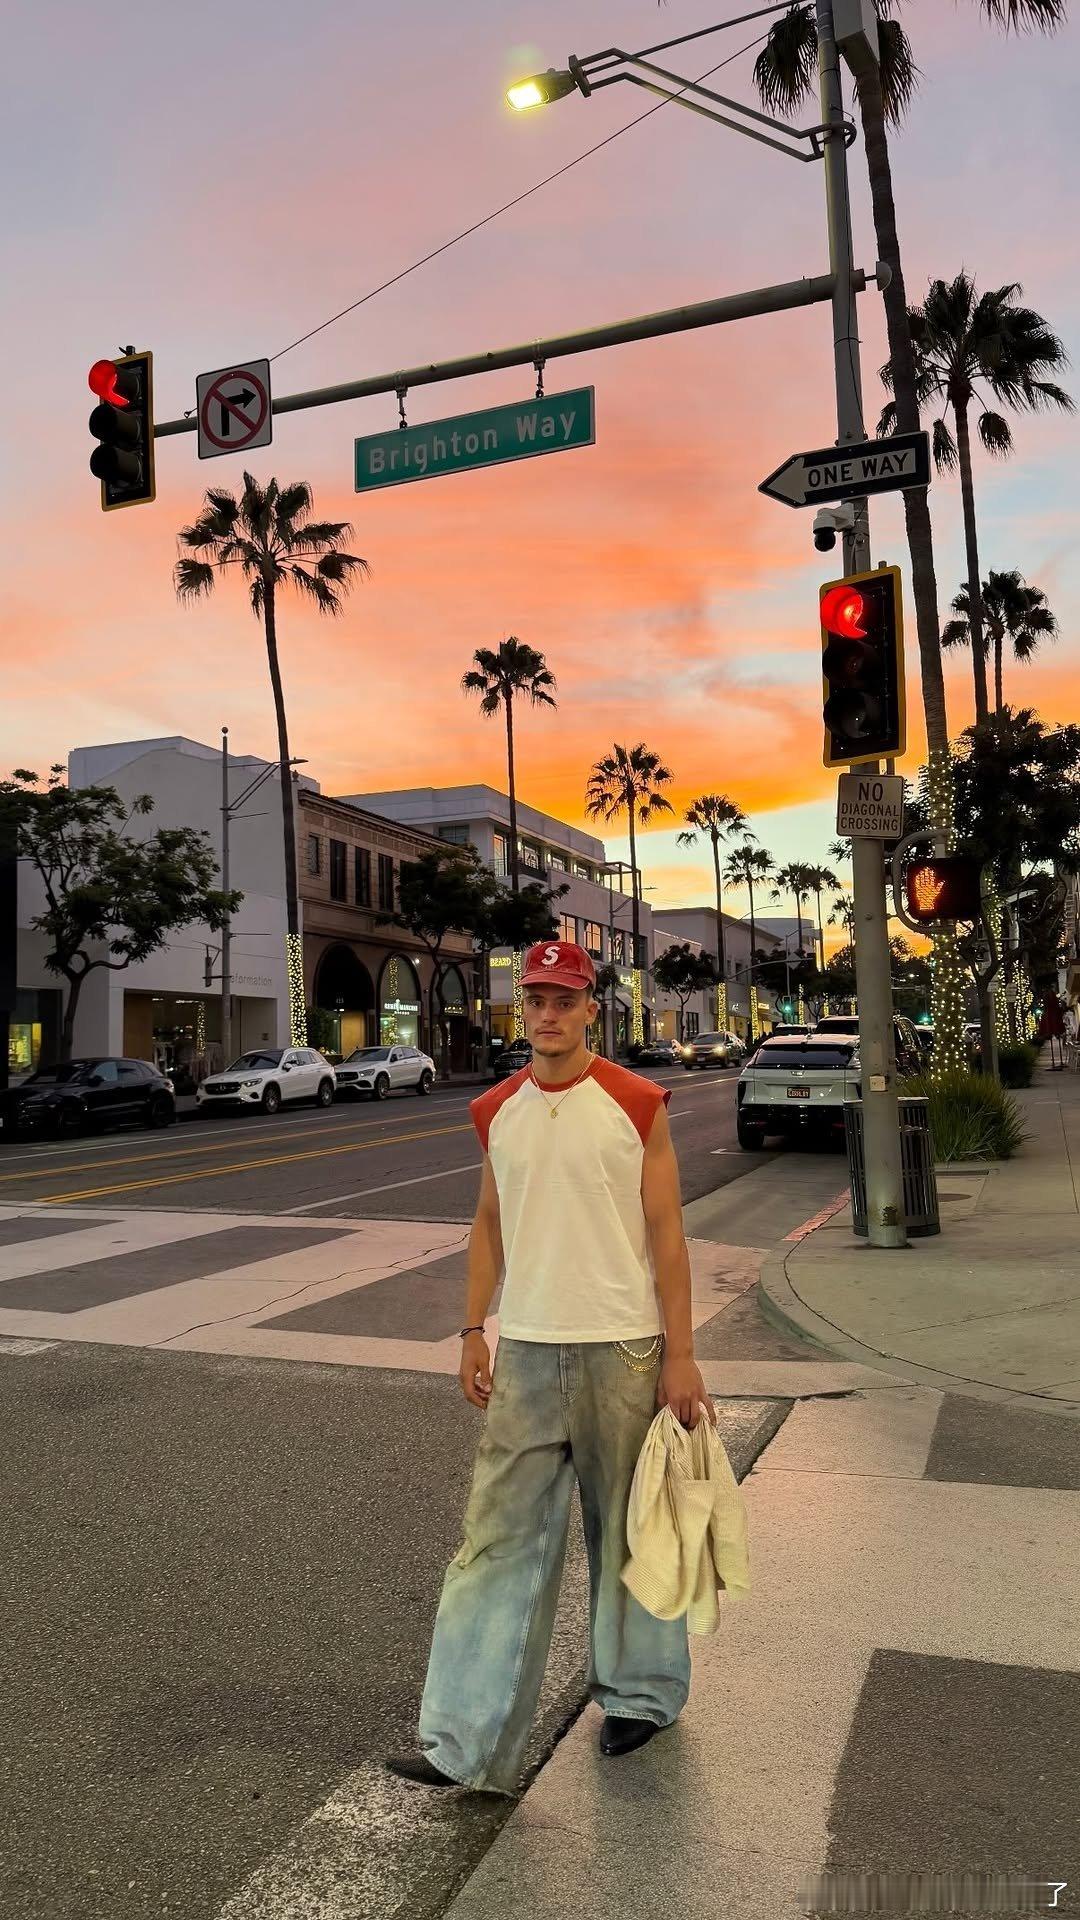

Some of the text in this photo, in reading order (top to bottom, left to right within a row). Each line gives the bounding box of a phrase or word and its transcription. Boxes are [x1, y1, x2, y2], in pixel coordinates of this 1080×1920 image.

[369, 410, 576, 474] Brighton Way
[807, 452, 909, 488] ONE WAY
[858, 782, 884, 802] NO
[841, 802, 900, 817] DIAGONAL
[840, 816, 898, 831] CROSSING
[541, 945, 561, 965] S
[229, 972, 273, 986] eformation
